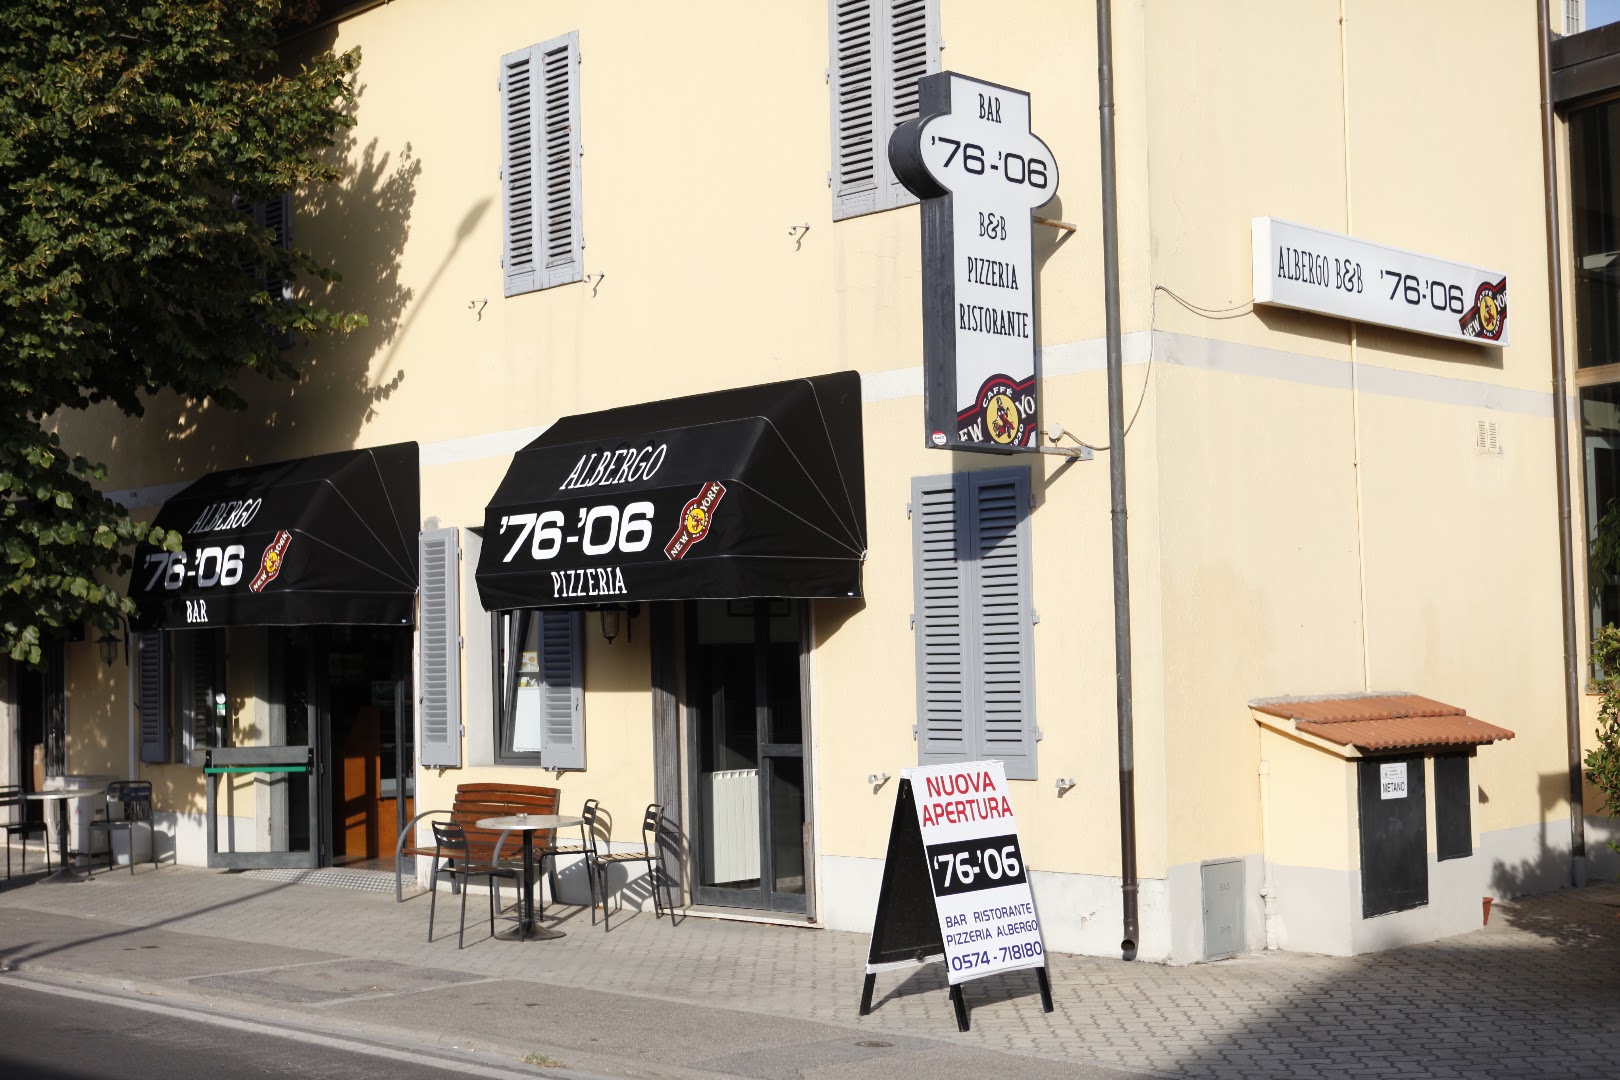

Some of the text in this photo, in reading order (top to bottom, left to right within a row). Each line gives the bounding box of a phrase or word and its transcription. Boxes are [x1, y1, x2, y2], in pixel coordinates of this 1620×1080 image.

[978, 93, 1002, 124] BAR
[978, 211, 1007, 241] B&B
[967, 256, 1019, 290] PIZZERIA
[1276, 245, 1330, 288] ALBERGO
[1334, 258, 1364, 294] B&B
[959, 303, 1029, 339] RISTORANTE
[958, 417, 985, 443] EW
[558, 443, 667, 490] ALBERGO
[187, 497, 262, 534] ALBERGO
[670, 482, 721, 558] NEW YORK
[499, 501, 655, 563] '76-'06
[253, 569, 267, 592] NEW
[550, 566, 628, 598] PIZZERIA
[185, 599, 209, 623] BAR
[925, 771, 997, 798] NUOVA
[1382, 781, 1406, 793] METANO
[922, 795, 1014, 828] APERTURA
[945, 902, 1033, 928] BAR RISTORANTE
[946, 919, 1038, 946] PIZZERIA ALBERGO
